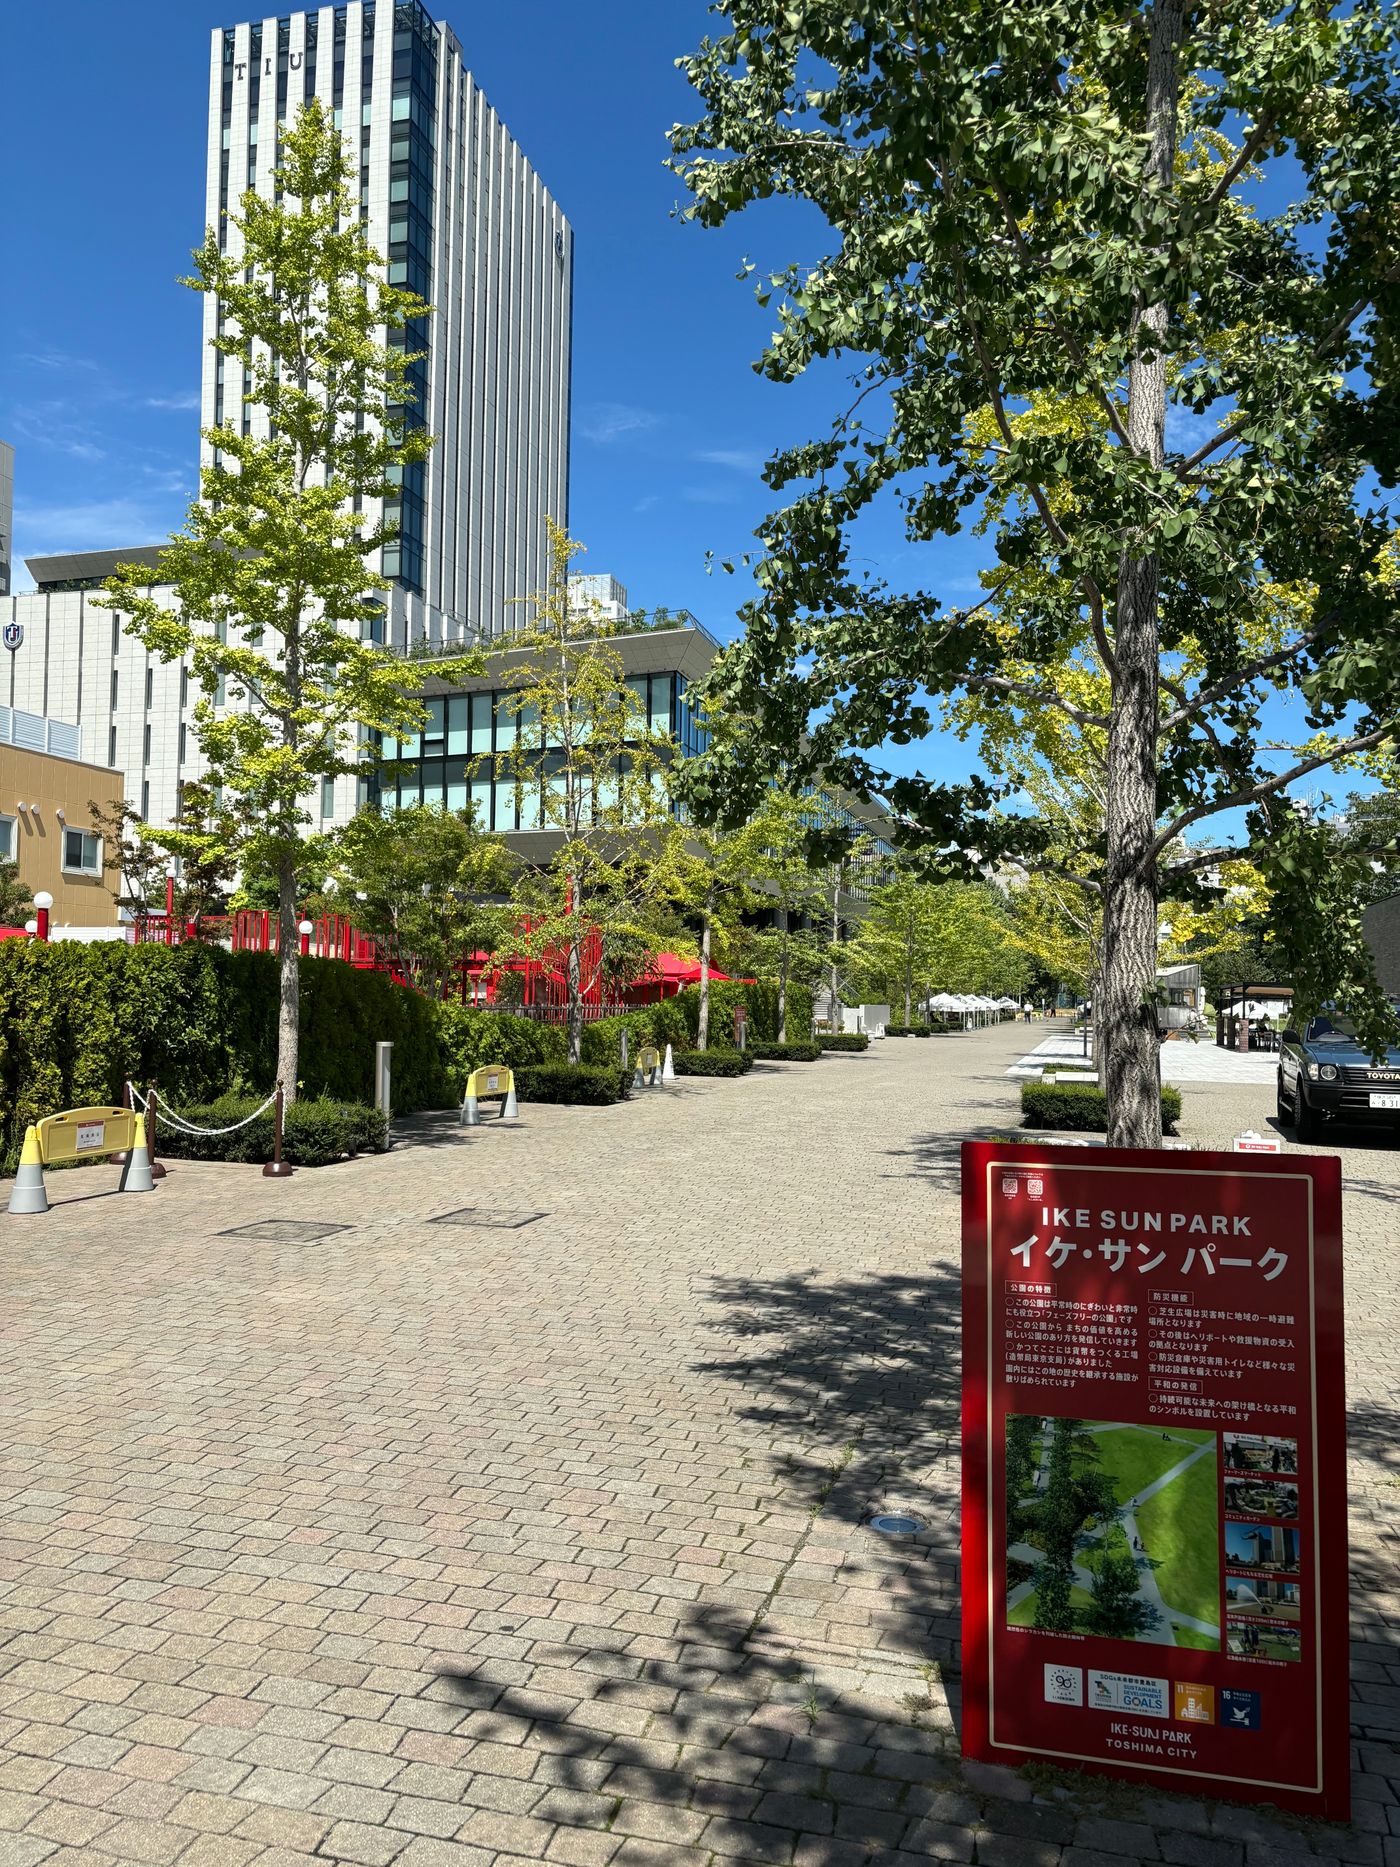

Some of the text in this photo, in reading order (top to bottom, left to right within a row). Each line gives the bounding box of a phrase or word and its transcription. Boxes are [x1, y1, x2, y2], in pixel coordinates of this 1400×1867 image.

[234, 52, 303, 81] TIU
[1367, 1072, 1400, 1080] TOYOTA
[1042, 1207, 1252, 1236] IKE SUN PARK
[1010, 1284, 1052, 1294] 公園の特徴
[1153, 1292, 1188, 1303] 防災機能
[1148, 1317, 1202, 1328] 場所となります
[1148, 1340, 1208, 1352] の拠点となります
[1154, 1379, 1198, 1391] 平和の発信
[1123, 1690, 1162, 1699] DEVELOPMENT
[1124, 1685, 1162, 1694] SUSTAINABLE
[1222, 1690, 1231, 1700] 16
[1123, 1696, 1163, 1709] GOALS
[1162, 1729, 1192, 1744] PARK
[1105, 1738, 1197, 1759] TOSHIMA CITY
